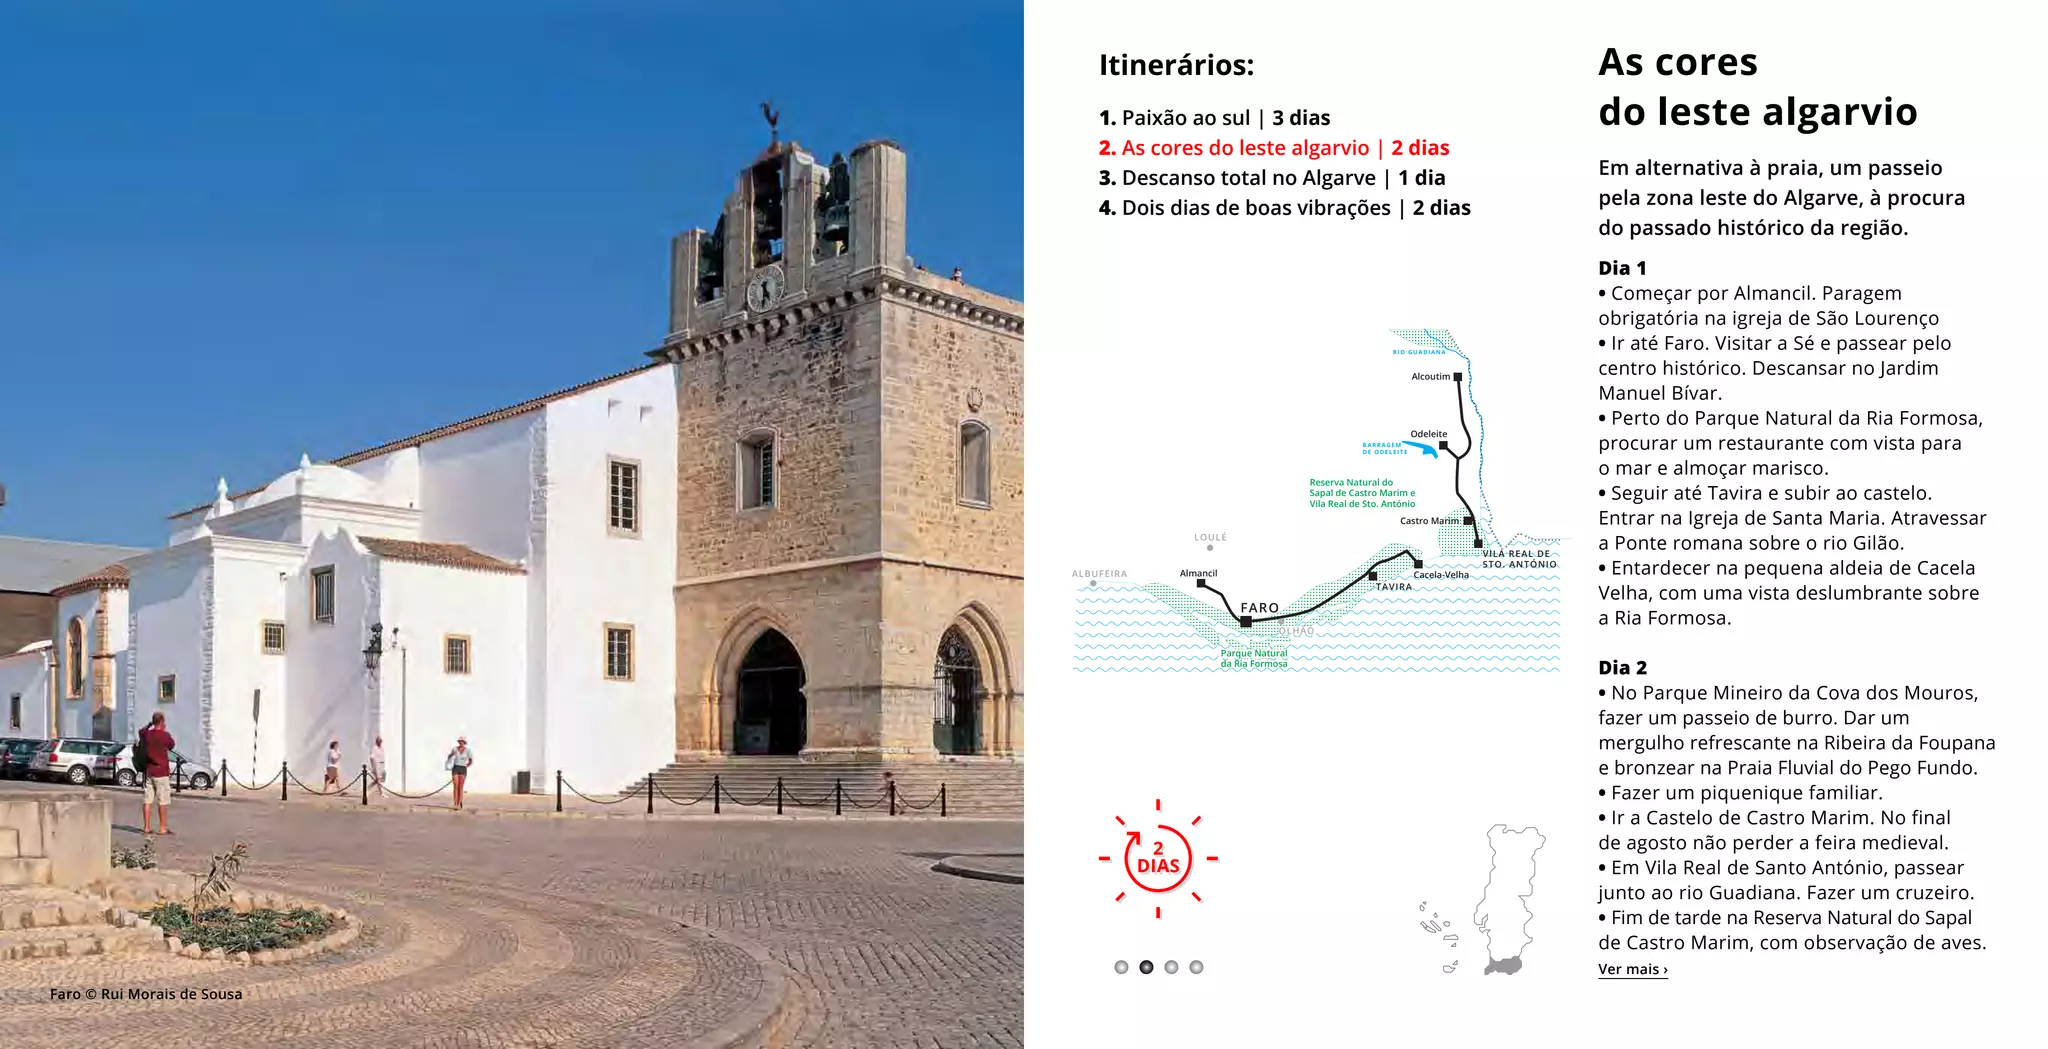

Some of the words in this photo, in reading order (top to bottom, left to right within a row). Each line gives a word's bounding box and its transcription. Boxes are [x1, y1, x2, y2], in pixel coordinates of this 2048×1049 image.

[1100, 52, 1254, 77] Itinerários:
[1597, 47, 1643, 76] As
[1655, 53, 1758, 77] cores
[1099, 109, 1117, 126] 1.
[1123, 108, 1187, 126] Paixão
[1192, 113, 1217, 126] ao
[1222, 108, 1250, 126] sul
[1272, 109, 1284, 126] 3
[1289, 108, 1331, 126] dias
[1599, 95, 1646, 126] do
[1659, 95, 1750, 126] leste
[1763, 95, 1918, 135] algarvio
[1098, 139, 1117, 156] 2.
[1121, 139, 1146, 157] As
[1150, 143, 1204, 156] cores
[1209, 138, 1234, 156] do
[1239, 138, 1286, 157] leste
[1291, 138, 1370, 161] algarvio
[1391, 139, 1404, 156] 2
[1408, 138, 1450, 156] dias
[1599, 159, 1629, 176] Em
[1635, 158, 1743, 176] alternativa
[1749, 158, 1761, 176] à
[1767, 158, 1824, 181] praia,
[1830, 163, 1862, 176] um
[1868, 158, 1943, 181] passeio
[1098, 169, 1117, 186] 3.
[1123, 169, 1216, 186] Descanso
[1220, 168, 1266, 186] total
[1273, 173, 1298, 186] no
[1302, 168, 1376, 191] Algarve
[1398, 169, 1408, 186] 1
[1415, 168, 1446, 186] dia
[1599, 188, 1640, 211] pela
[1646, 192, 1693, 206] zona
[1700, 188, 1747, 206] leste
[1753, 188, 1778, 206] do
[1783, 188, 1864, 211] Algarve,
[1869, 188, 1881, 206] à
[1888, 192, 1965, 211] procura
[1098, 199, 1117, 216] 4.
[1123, 199, 1165, 216] Dois
[1170, 198, 1211, 216] dias
[1215, 198, 1240, 216] de
[1246, 198, 1292, 216] boas
[1296, 198, 1391, 221] vibrações
[1412, 199, 1425, 216] 2
[1429, 198, 1472, 216] dias
[1598, 218, 1624, 236] do
[1630, 218, 1712, 241] passado
[1718, 218, 1805, 236] histórico
[1810, 218, 1834, 236] da
[1841, 218, 1909, 241] região.
[1599, 259, 1631, 276] Dia
[1636, 260, 1646, 276] 1
[1611, 285, 1692, 305] Começar
[1698, 288, 1729, 305] por
[1733, 284, 1816, 301] Almancil.
[1823, 285, 1902, 305] Paragem
[1598, 309, 1698, 330] obrigatória
[1705, 313, 1726, 326] na
[1733, 310, 1782, 330] igreja
[1788, 309, 1811, 326] de
[1816, 310, 1849, 326] São
[1855, 310, 1940, 330] Lourenço
[1412, 373, 1451, 381] Alcoutim
[1599, 384, 1665, 401] Manuel
[1672, 384, 1722, 401] Bívar.
[1612, 410, 1660, 426] Perto
[1666, 409, 1689, 426] do
[1695, 410, 1760, 430] Parque
[1766, 409, 1832, 426] Natural
[1838, 409, 1860, 426] da
[1867, 410, 1893, 426] Ria
[1900, 410, 1983, 428] Formosa,
[1410, 430, 1447, 438] Odeleite
[1599, 438, 1678, 455] procurar
[1683, 438, 1712, 451] um
[1718, 436, 1824, 451] restaurante
[1830, 438, 1868, 451] com
[1873, 435, 1915, 451] vista
[1921, 438, 1962, 455] para
[1310, 478, 1345, 487] Reserva
[1346, 478, 1379, 486] Natural
[1381, 478, 1393, 486] do
[1310, 489, 1333, 498] Sapal
[1335, 489, 1347, 497] de
[1349, 489, 1377, 497] Castro
[1379, 489, 1407, 497] Marim
[1409, 490, 1416, 498] e
[1310, 499, 1326, 508] Vila
[1328, 499, 1347, 508] Real
[1349, 499, 1360, 508] de
[1361, 499, 1379, 508] Sto.
[1381, 499, 1416, 508] António
[1400, 517, 1429, 525] Castro
[1431, 517, 1459, 525] Marim
[1194, 532, 1227, 541] LOULÉ
[1483, 549, 1505, 558] VILA
[1509, 549, 1532, 558] REAL
[1538, 549, 1550, 558] DE
[1483, 560, 1505, 569] STO.
[1509, 559, 1557, 568] ANTÓNIO
[1612, 559, 1711, 576] Entardecer
[1716, 563, 1738, 576] na
[1744, 563, 1823, 580] pequena
[1829, 559, 1883, 576] aldeia
[1889, 559, 1912, 576] de
[1917, 559, 1975, 576] Cacela
[1072, 570, 1127, 578] ALBUFEIRA
[1180, 569, 1218, 577] Almancil
[1414, 571, 1469, 579] Cacela-Velha
[1376, 582, 1412, 591] TAVIRA
[1241, 603, 1279, 613] FARO
[1279, 625, 1314, 634] OLHÃO
[1221, 650, 1252, 659] Parque
[1254, 649, 1288, 657] Natural
[1221, 659, 1232, 667] da
[1234, 659, 1247, 667] Ria
[1250, 659, 1288, 667] Formosa
[1599, 659, 1631, 676] Dia
[1636, 660, 1648, 676] 2
[1599, 734, 1685, 755] mergulho
[1690, 734, 1792, 751] refrescante
[1797, 738, 1818, 751] na
[1825, 734, 1886, 751] Ribeira
[1891, 734, 1913, 751] da
[1919, 735, 1996, 755] Foupana
[1612, 785, 1661, 801] Fazer
[1666, 788, 1694, 801] um
[1701, 784, 1803, 805] piquenique
[1808, 784, 1883, 801] familiar.
[1153, 842, 1163, 855] 2
[1137, 858, 1180, 873] DIAS
[1598, 934, 1621, 951] de
[1626, 934, 1685, 951] Castro
[1691, 934, 1754, 953] Marim,
[1760, 938, 1798, 951] com
[1804, 934, 1908, 955] observação
[1913, 934, 1936, 951] de
[1941, 938, 1987, 951] aves.
[1597, 963, 1623, 976] Ver
[1626, 963, 1660, 976] mais
